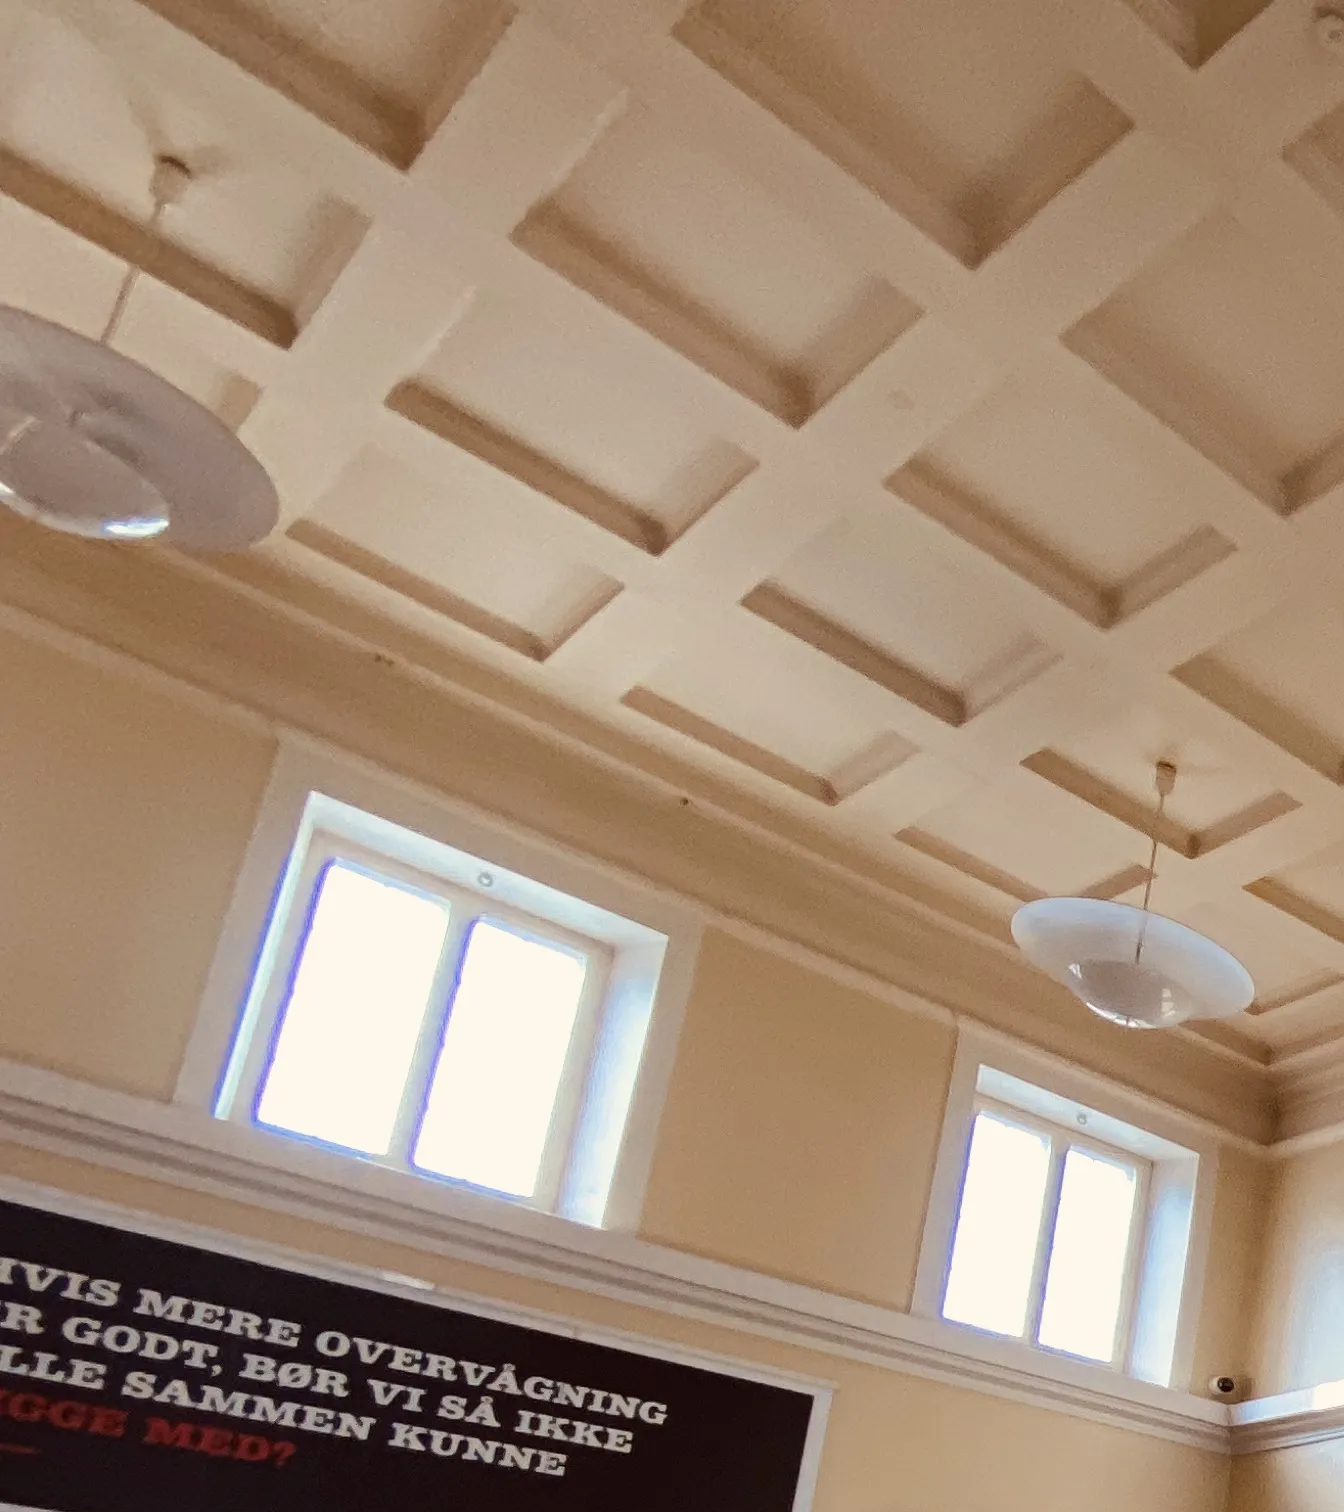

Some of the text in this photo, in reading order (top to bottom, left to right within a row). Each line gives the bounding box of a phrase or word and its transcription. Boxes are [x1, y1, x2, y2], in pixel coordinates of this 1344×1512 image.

[0, 1301, 634, 1453] R GODT, BØR VI SÅ IKKE
[133, 1288, 302, 1347] MERE
[315, 1331, 668, 1425] OVERVÅGNING
[0, 1388, 297, 1468] GGE MED?
[121, 1371, 377, 1440] SAMMEN
[388, 1422, 568, 1476] KUNNE
